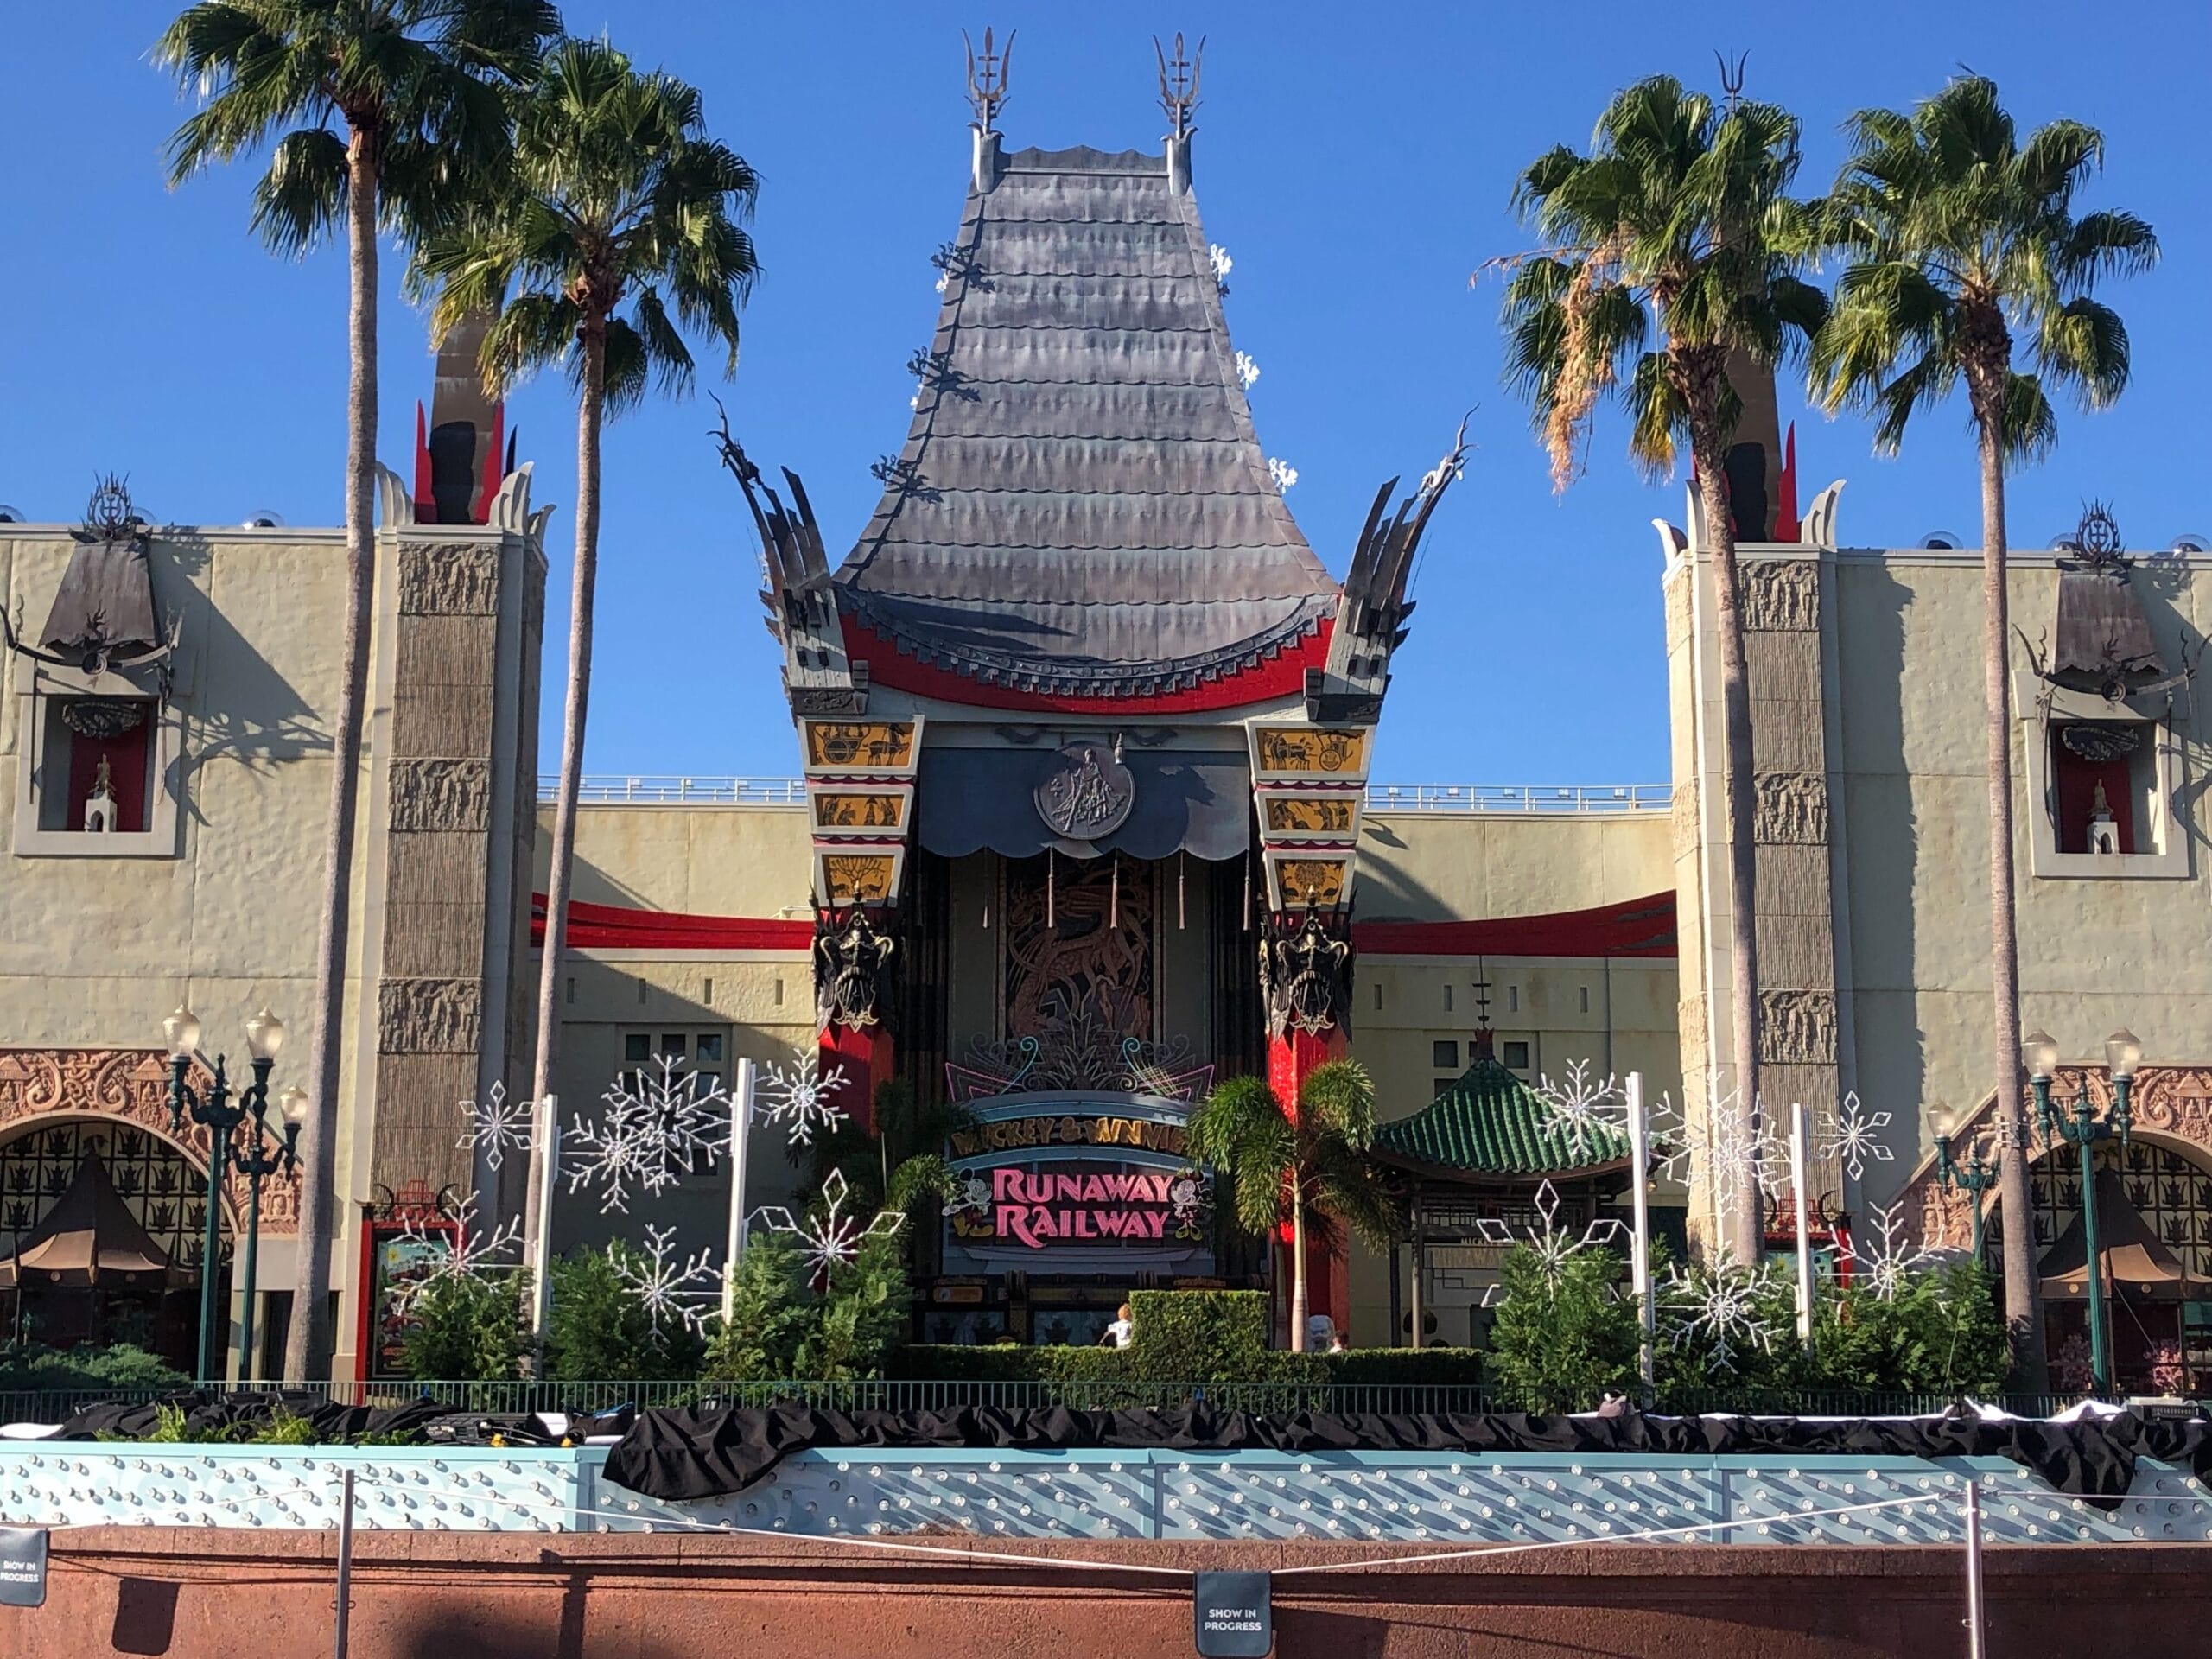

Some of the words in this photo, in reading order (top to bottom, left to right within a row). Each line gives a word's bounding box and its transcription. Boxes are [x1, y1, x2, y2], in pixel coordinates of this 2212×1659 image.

[1060, 1116, 1080, 1142] &
[994, 1169, 1173, 1204] RUNAWAY
[996, 1206, 1169, 1249] RAILWAY
[3, 1560, 25, 1570] SHOW
[1209, 1609, 1243, 1618] SHOW
[1244, 1609, 1257, 1618] IN
[1204, 1621, 1262, 1631] PROGRESS
